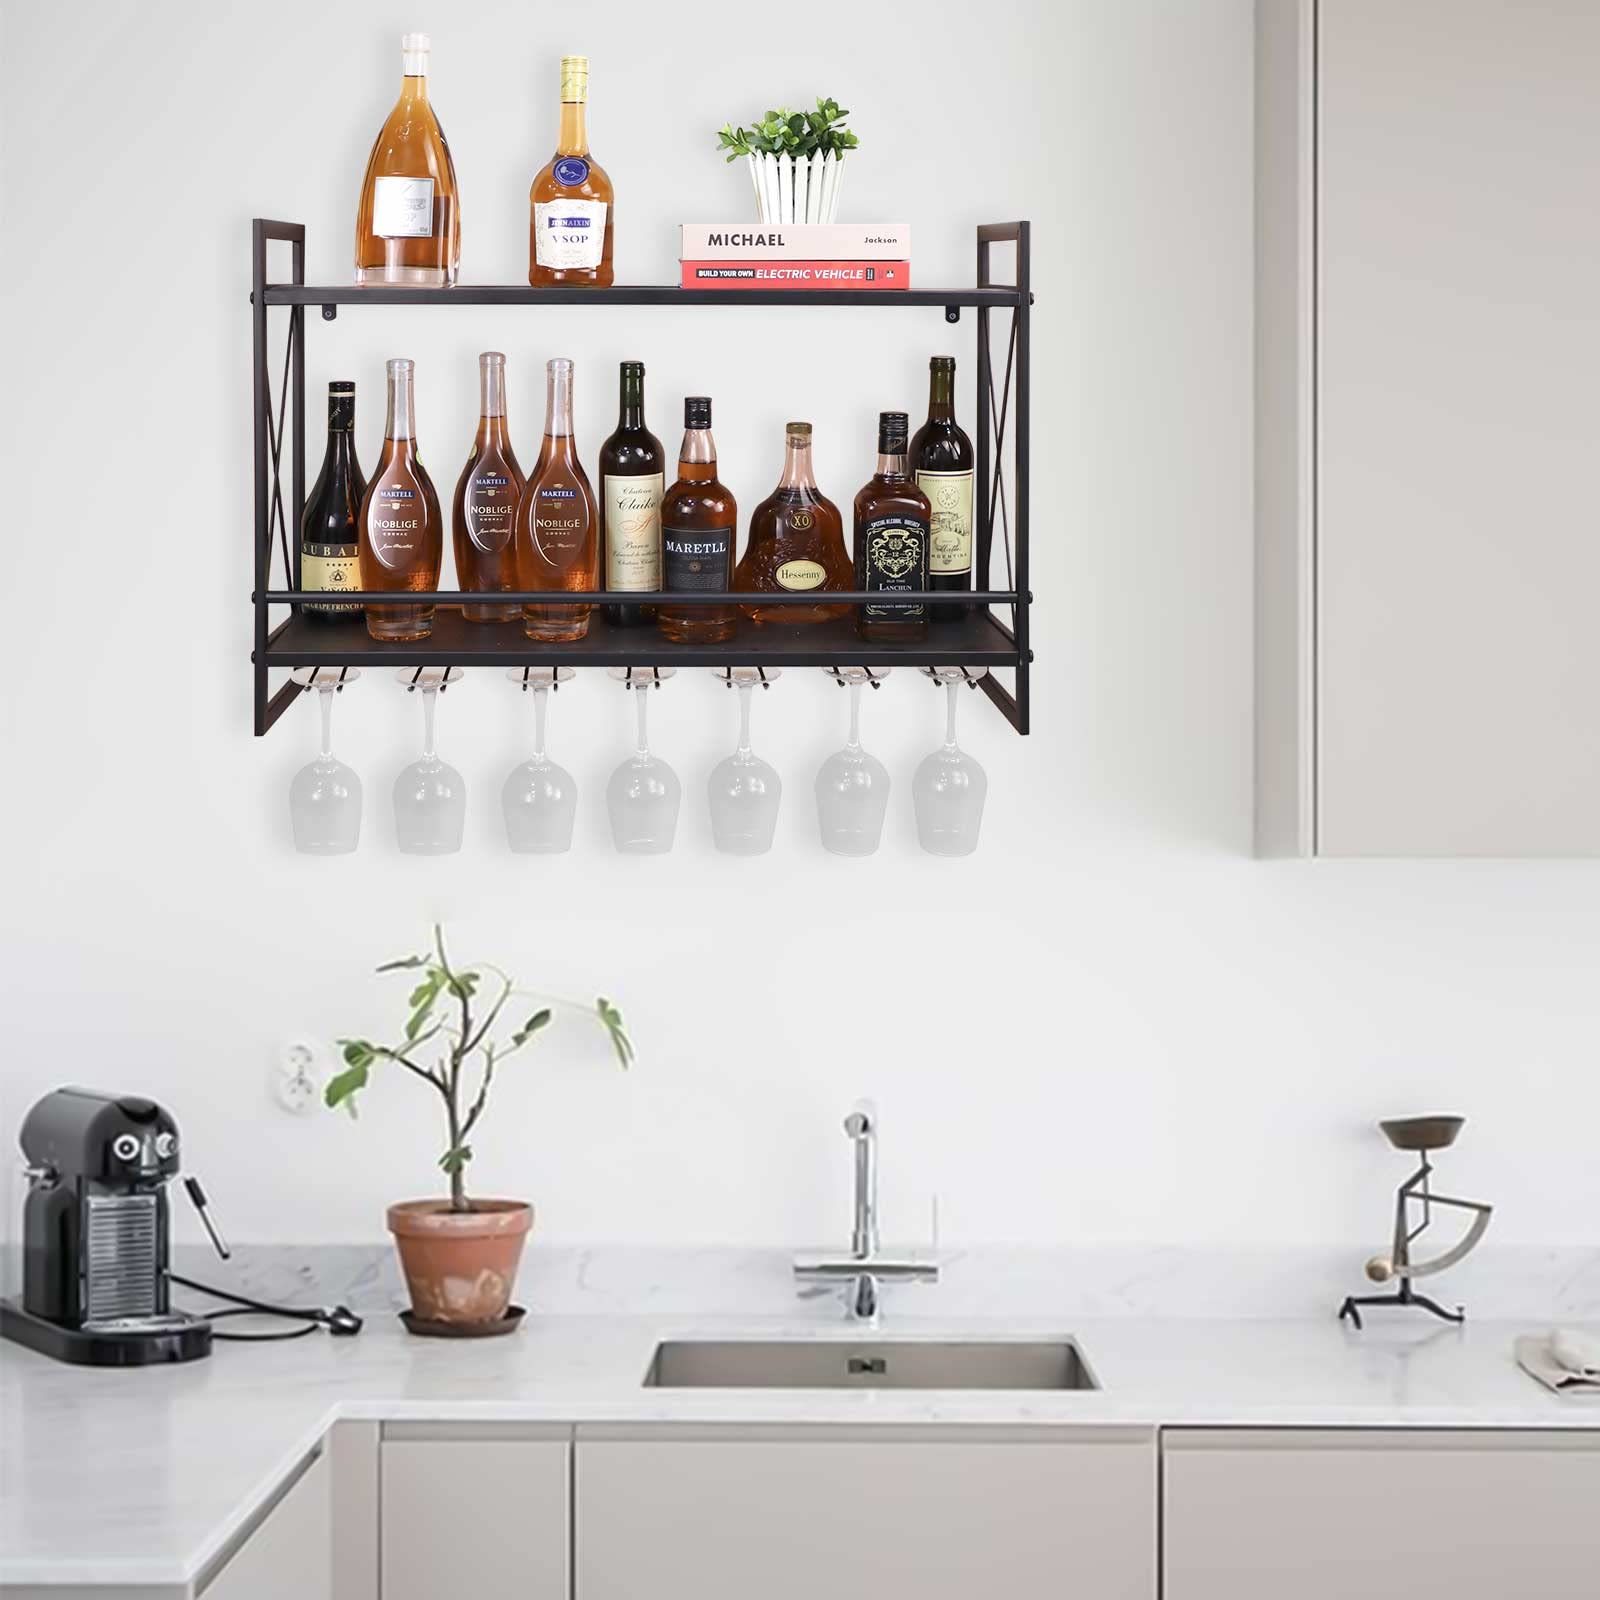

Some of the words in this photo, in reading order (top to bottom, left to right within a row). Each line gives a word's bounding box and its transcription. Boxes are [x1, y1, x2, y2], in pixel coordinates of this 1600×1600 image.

[708, 234, 784, 246] MICHAEL
[756, 269, 810, 279] ELECTRIC
[814, 269, 863, 279] VEHICLE
[471, 505, 513, 514] NOBLIGE
[374, 520, 418, 529] NOBLIGE
[536, 519, 580, 528] NOBLIGE
[794, 515, 809, 526] XO
[666, 540, 726, 553] MARETLL
[781, 569, 820, 581] Hessenny
[880, 583, 912, 591] LANCHUN
